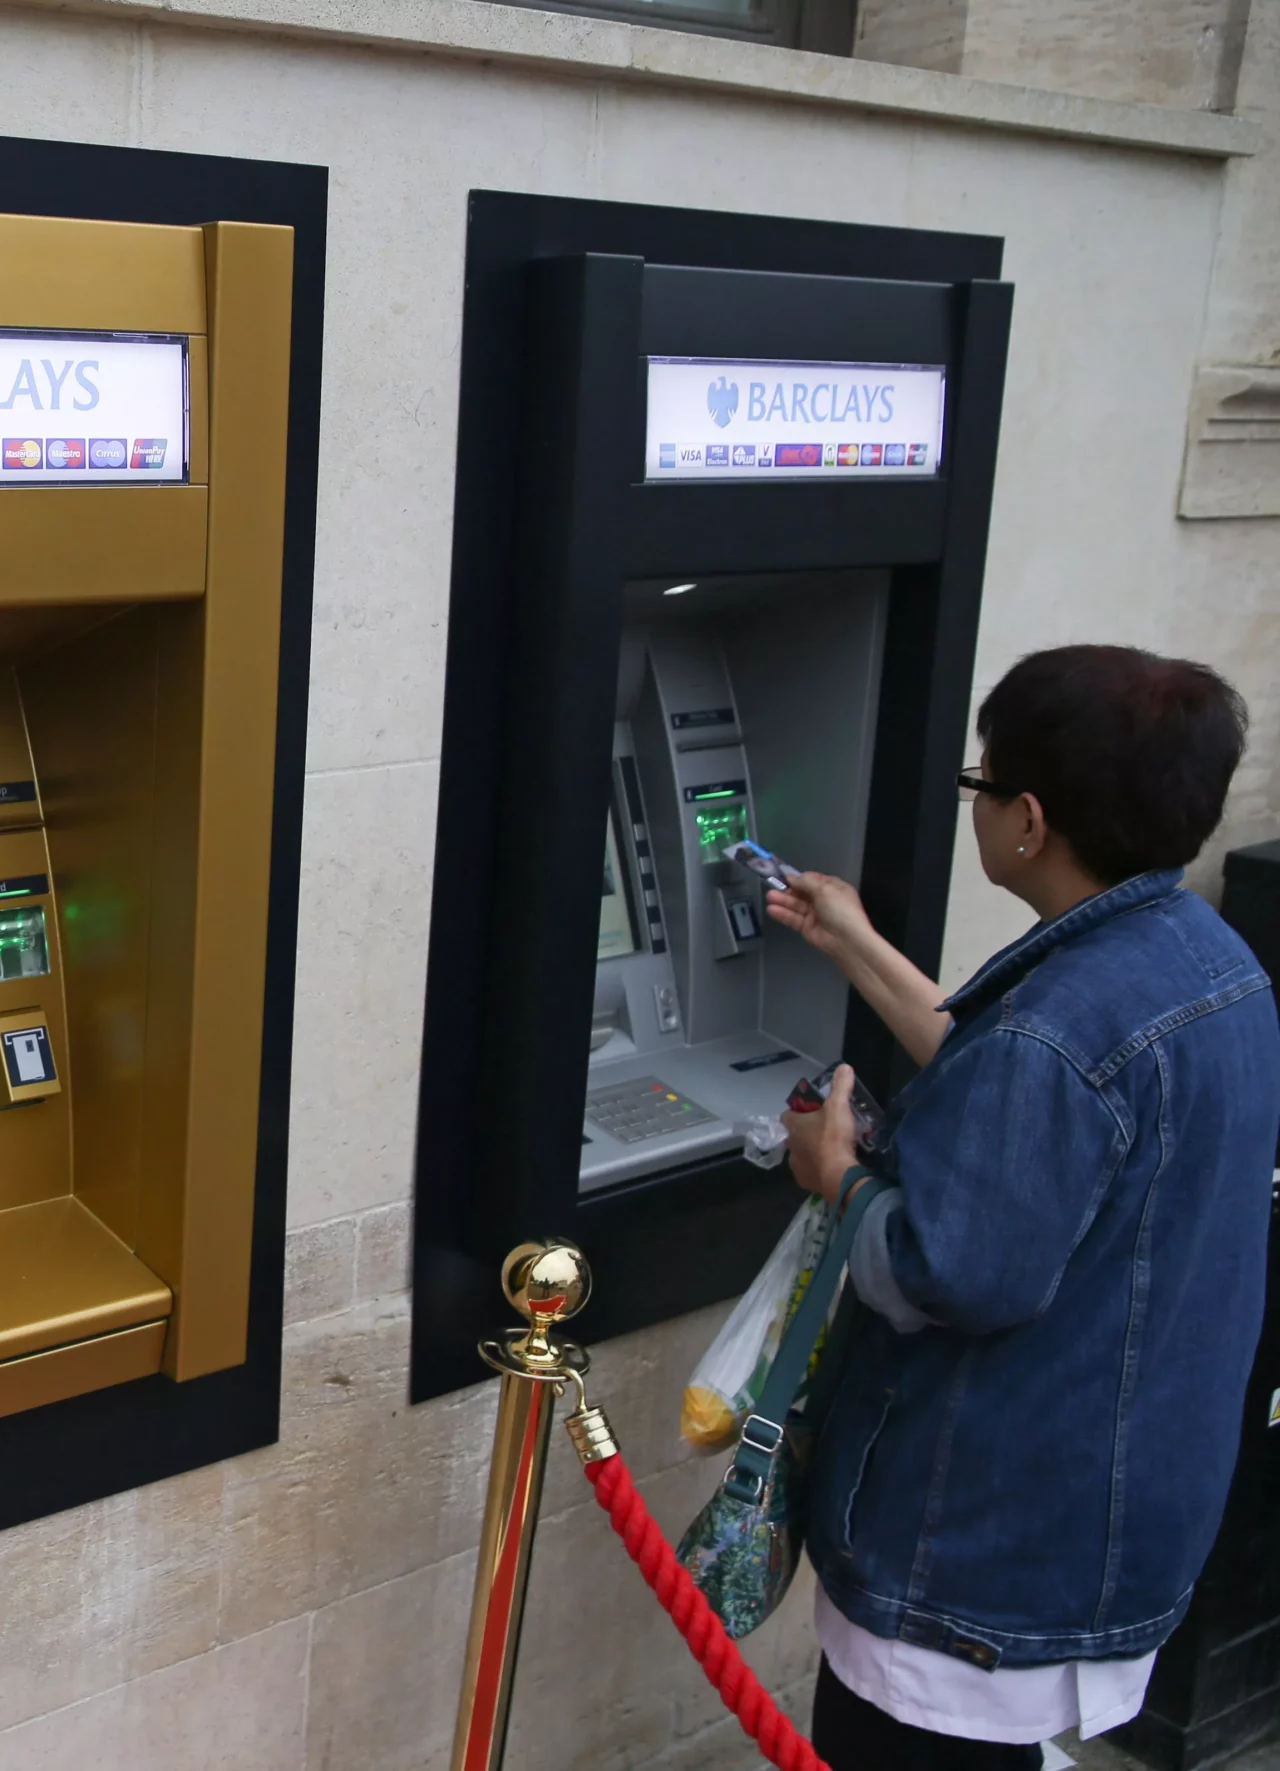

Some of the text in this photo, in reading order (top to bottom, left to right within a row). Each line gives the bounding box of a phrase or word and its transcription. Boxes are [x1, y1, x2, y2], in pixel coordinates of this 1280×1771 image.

[747, 382, 895, 424] BARCLAYS
[5, 449, 41, 459] MasterCard
[51, 449, 81, 458] Maestro
[95, 449, 121, 458] Cirrus
[133, 445, 165, 455] UnionPay
[680, 449, 702, 461] VISA
